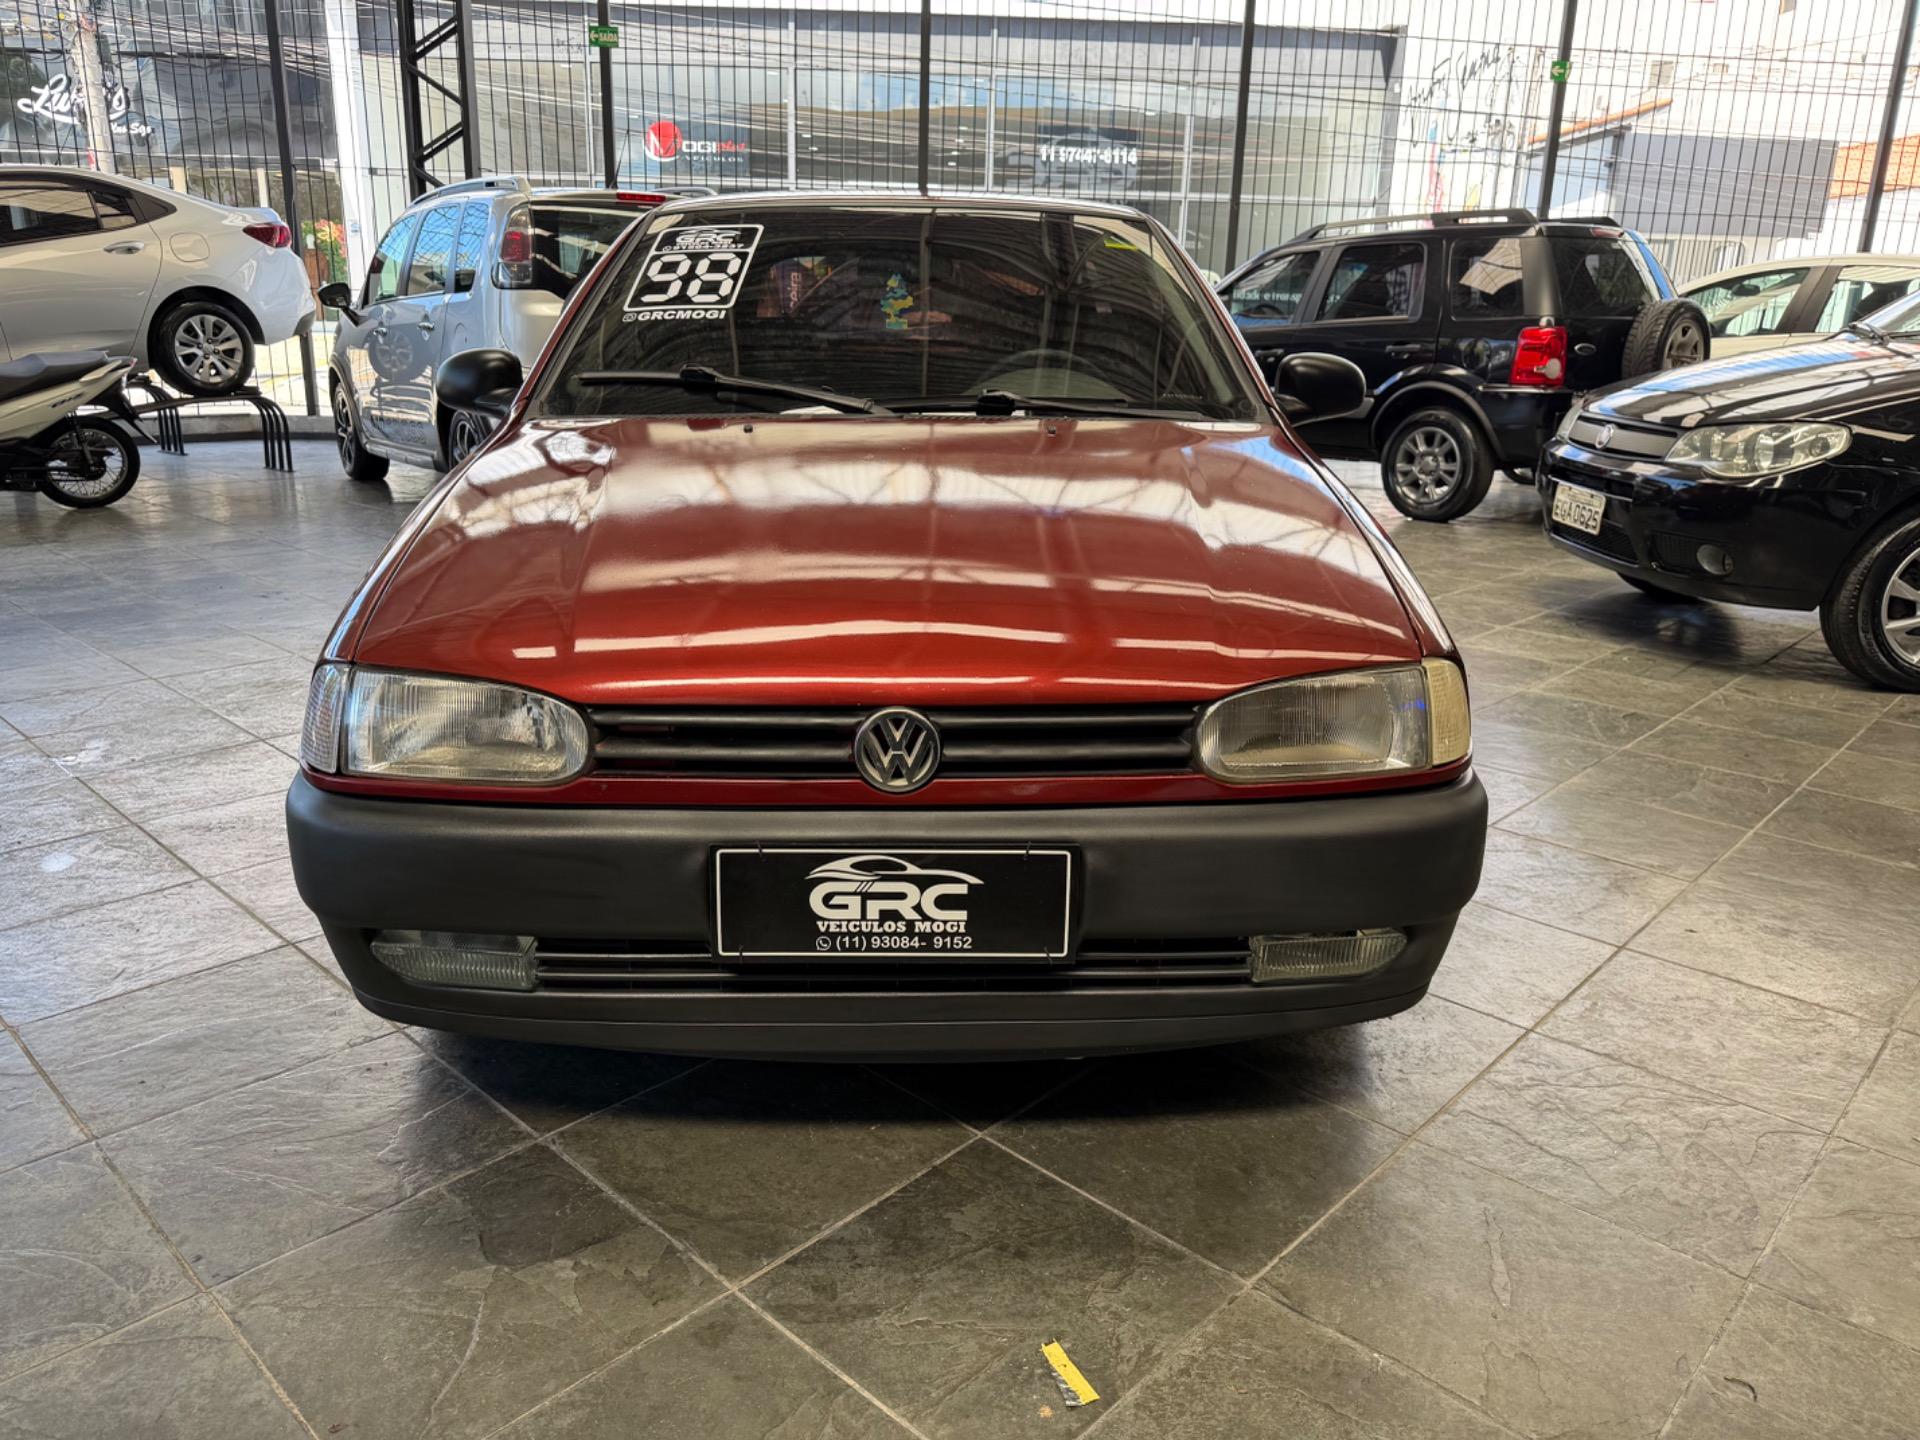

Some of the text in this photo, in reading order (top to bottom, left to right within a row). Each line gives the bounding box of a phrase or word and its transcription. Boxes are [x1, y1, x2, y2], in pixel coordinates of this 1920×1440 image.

[641, 253, 741, 303] 98
[809, 881, 967, 920] GRC
[817, 921, 966, 933] VEICULOS MOGI
[836, 936, 867, 951] (11)
[933, 936, 972, 949] 9152
